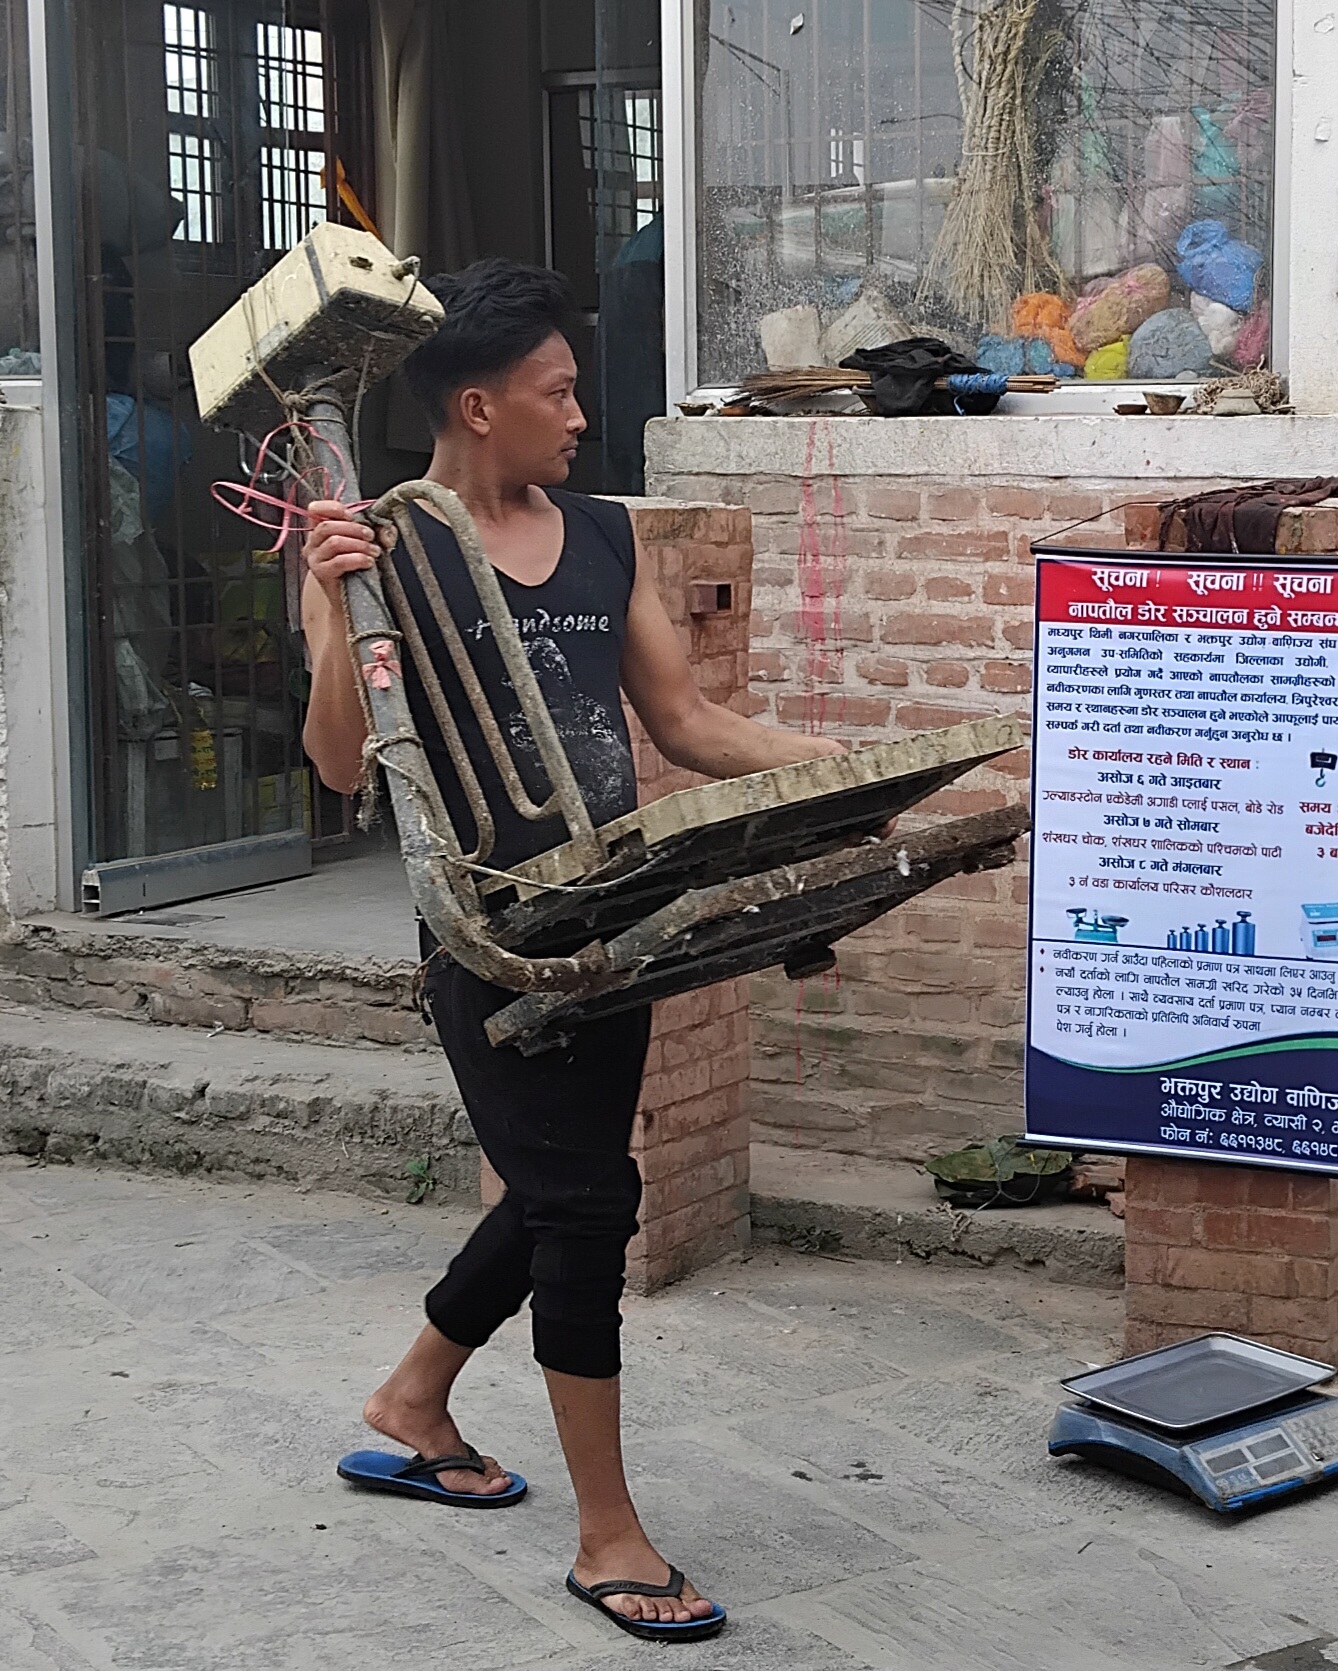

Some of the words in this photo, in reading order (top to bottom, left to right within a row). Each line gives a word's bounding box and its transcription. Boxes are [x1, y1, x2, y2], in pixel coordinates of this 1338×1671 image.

[1091, 567, 1149, 592] सूचना
[1187, 571, 1247, 595] सूचना
[1273, 574, 1334, 598] सूचना
[1068, 598, 1134, 620] नापतौल
[1138, 600, 1168, 622] डोर
[1253, 605, 1282, 630] हुने
[1118, 629, 1179, 642] नगरपालिका
[1184, 634, 1192, 644] र
[1197, 634, 1233, 647] भक्तपुर
[1239, 634, 1267, 646] उद्योग
[1272, 635, 1313, 648] वाणिज्य
[1319, 638, 1337, 649] संघ
[1047, 646, 1091, 658] अनुगमन
[1173, 651, 1225, 663] सहकार्यमा
[1236, 652, 1284, 666] जिल्लाका
[1114, 666, 1142, 678] प्रयोग
[1169, 669, 1203, 681] आएको
[1209, 671, 1264, 684] नापतौलका
[1046, 681, 1105, 695] नवीकरणका
[1107, 684, 1132, 696] लागि
[1134, 688, 1173, 700] गुणस्तर
[1175, 690, 1195, 700] तथा
[1197, 689, 1238, 702] नापतौल
[1046, 702, 1072, 711] समय
[1075, 703, 1083, 713] र
[1141, 704, 1159, 717] डोर
[1209, 708, 1226, 722] हुने
[1229, 710, 1269, 723] भएकोले
[1046, 719, 1078, 730] सम्पर्क
[1081, 720, 1100, 732] गरी
[1103, 722, 1121, 733] दर्ता
[1124, 724, 1144, 734] तथा
[1147, 724, 1192, 737] नवीकरण
[1231, 729, 1269, 743] अनुरोध
[1272, 732, 1283, 742] छ
[1068, 746, 1089, 760] डोर
[1093, 749, 1144, 763] कार्यालय
[1146, 751, 1173, 766] रहने
[1177, 752, 1203, 767] मिति
[1207, 757, 1216, 768] र
[1219, 757, 1251, 770] स्थान
[1097, 770, 1134, 784] असोज
[1137, 774, 1144, 786] ६
[1148, 772, 1167, 786] गते
[1170, 776, 1222, 790] आइतबार
[1147, 796, 1178, 808] अगाडी
[1182, 796, 1209, 812] प्लाई
[1245, 799, 1262, 814] बोडे
[1266, 801, 1284, 815] रोड
[1299, 801, 1332, 814] समय
[1103, 812, 1140, 827] असोज
[1143, 817, 1151, 828] ७
[1154, 815, 1173, 830] गते
[1176, 817, 1220, 833] सोमबार
[1151, 838, 1203, 853] शालिकको
[1207, 842, 1258, 856] पश्चिमको
[1261, 846, 1282, 858] पाटी
[1317, 847, 1325, 858] ३
[1099, 855, 1135, 869] असोज
[1139, 860, 1146, 870] ८
[1150, 858, 1169, 872] गते
[1172, 860, 1223, 877] मंगलबार
[1069, 876, 1075, 887] ३
[1092, 878, 1109, 888] वडा
[1113, 877, 1160, 892] कार्यालय
[1162, 881, 1197, 895] परिसर
[1200, 883, 1253, 900] कौशलटार
[1053, 948, 1098, 962] नवीकरण
[1100, 950, 1120, 963] गर्न
[1151, 955, 1194, 970] पहिलाको
[1196, 961, 1223, 972] प्रमाण
[1226, 963, 1240, 974] पत्र
[1244, 965, 1277, 977] साथमा
[1280, 965, 1306, 979] लिएर
[1309, 969, 1336, 985] आउनु
[1079, 967, 1110, 981] दर्ताको
[1115, 971, 1139, 983] लागि
[1143, 973, 1181, 987] नापतौल
[1185, 978, 1217, 991] सामग्री
[1221, 980, 1248, 994] खरिद
[1253, 982, 1285, 996] गरेको
[1290, 987, 1302, 998] ३५
[1056, 986, 1089, 1001] ल्याउनु
[1093, 985, 1115, 1000] होला
[1129, 989, 1149, 1002] साथै
[1152, 993, 1194, 1006] व्यवसाय
[1198, 995, 1216, 1009] दर्ता
[1219, 1000, 1246, 1012] प्रमाण
[1271, 1004, 1296, 1015] प्यान
[1300, 1006, 1331, 1018] नम्बर
[1057, 1004, 1071, 1014] पत्र
[1074, 1005, 1081, 1015] र
[1084, 1006, 1148, 1021] नागरिकताको
[1151, 1010, 1189, 1024] प्रतिलिपि
[1192, 1014, 1231, 1028] अनिवार्य
[1056, 1019, 1072, 1033] पेश
[1075, 1021, 1094, 1038] गर्नु
[1096, 1022, 1118, 1036] होला
[1160, 1077, 1223, 1104] भक्तपुर
[1229, 1083, 1279, 1104] उद्योग
[1161, 1099, 1227, 1121] औद्योगिक
[1231, 1106, 1257, 1127] क्षेत्र,
[1264, 1114, 1307, 1130] व्यासी
[1160, 1123, 1191, 1142] फोन
